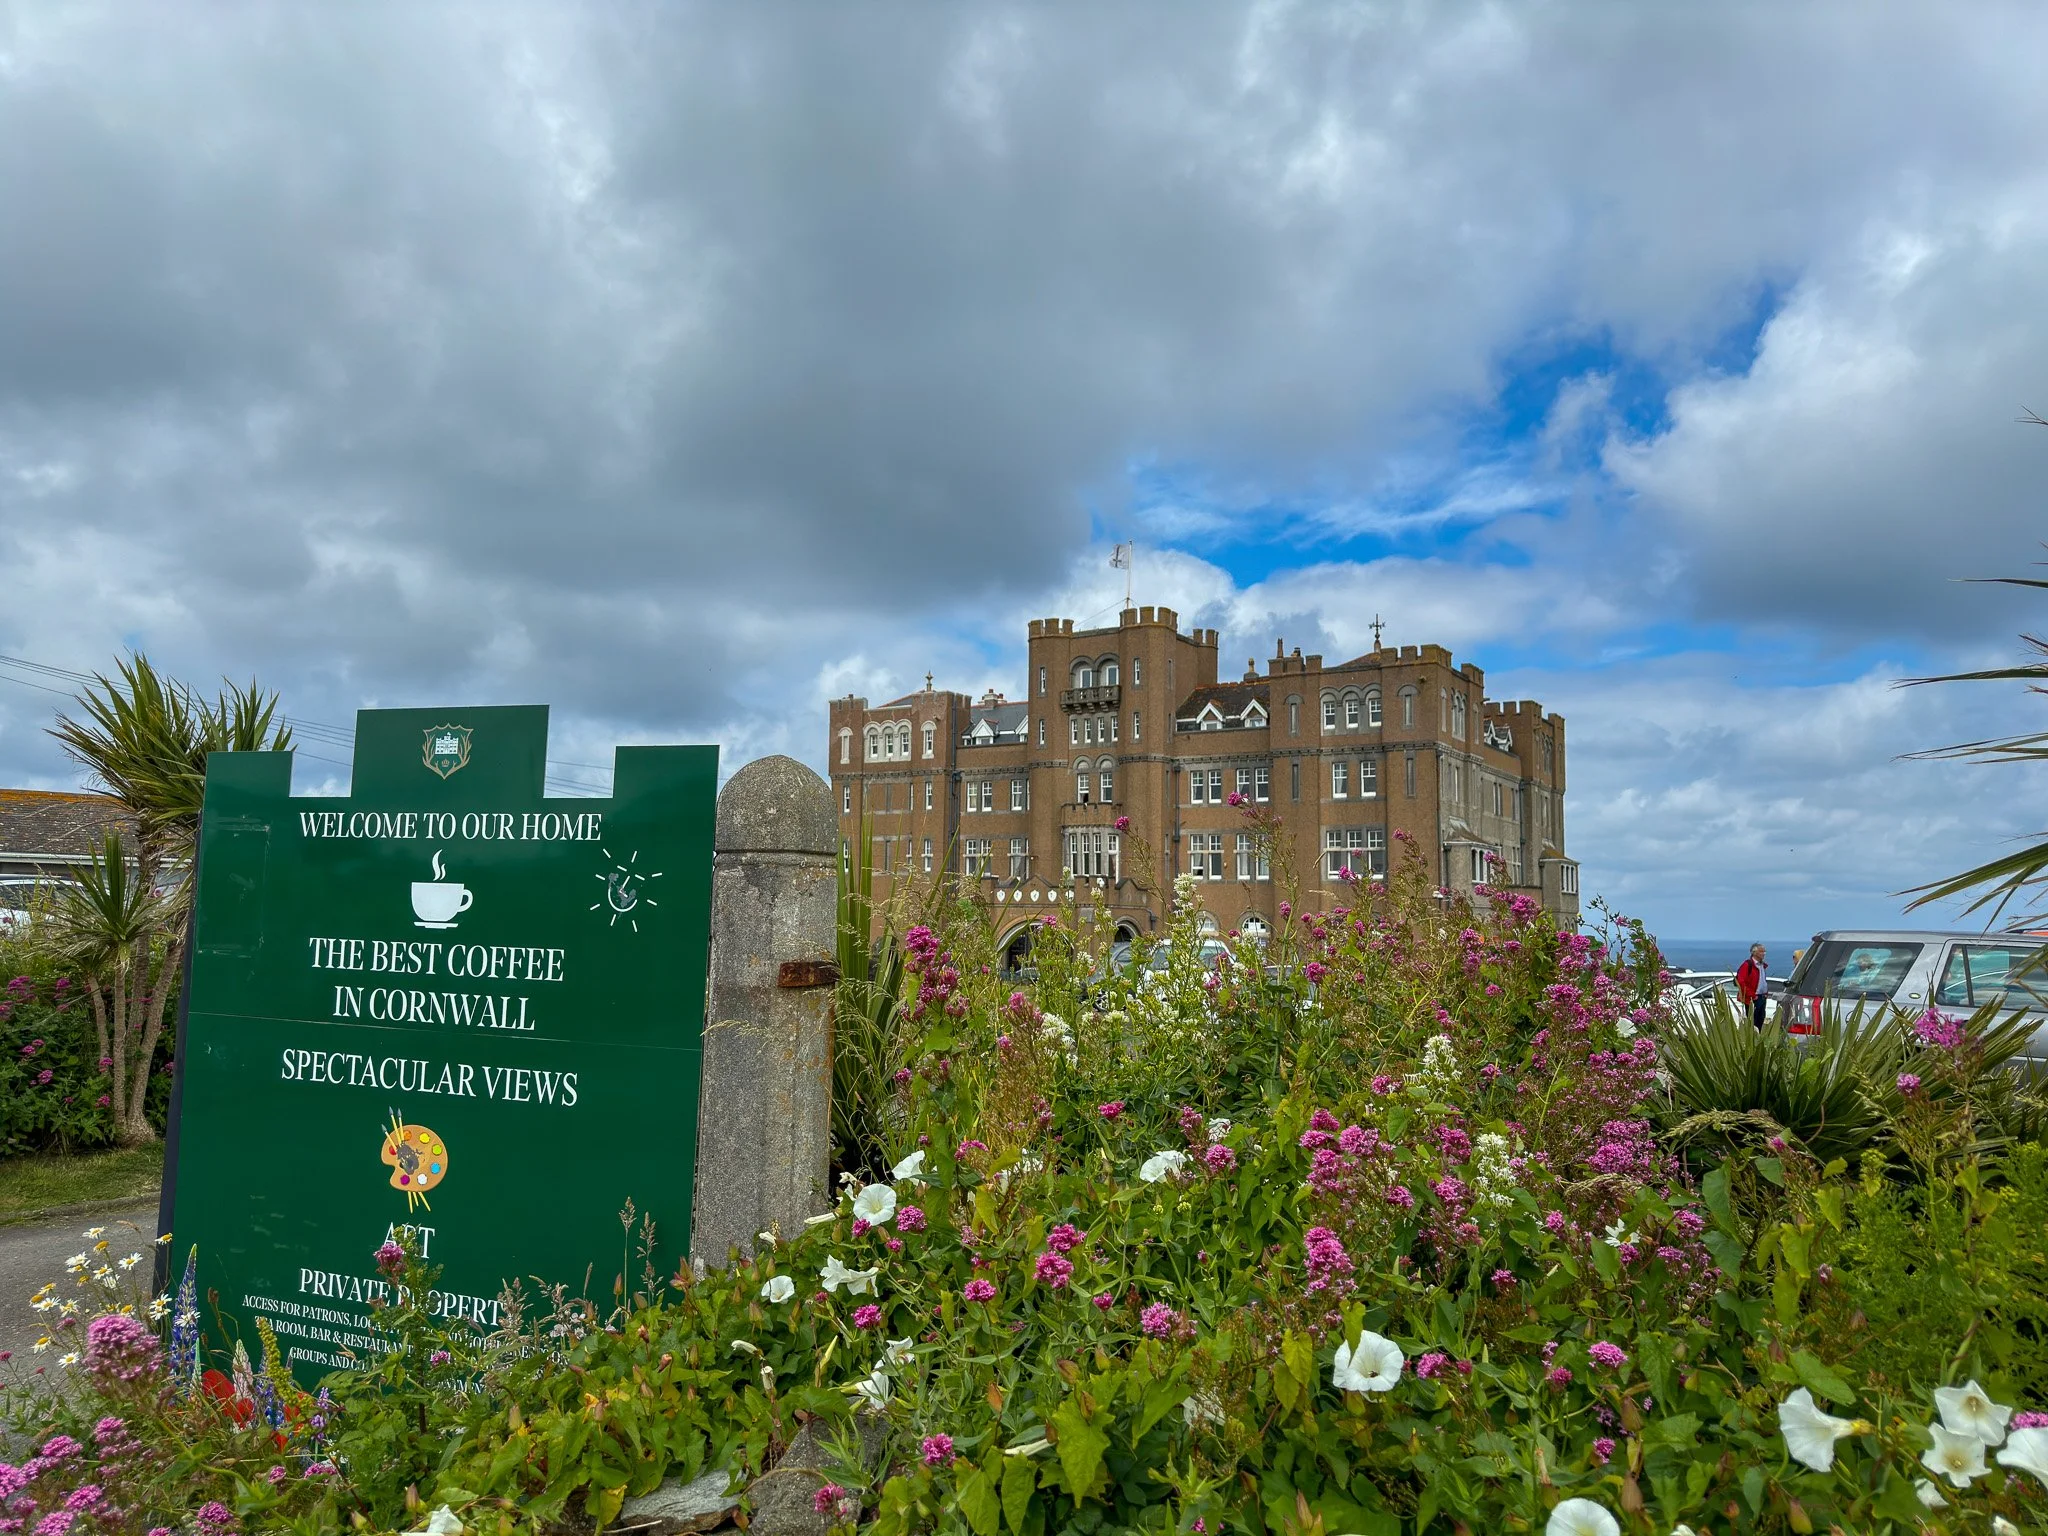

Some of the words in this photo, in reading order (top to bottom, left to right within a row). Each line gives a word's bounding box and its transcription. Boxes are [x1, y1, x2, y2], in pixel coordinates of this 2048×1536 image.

[300, 812, 418, 838] WELCOME
[423, 813, 456, 839] TO
[461, 813, 515, 840] OUR
[519, 813, 602, 841] HOME
[309, 937, 365, 970] THE
[370, 940, 442, 974] BEST
[447, 944, 565, 981] COFFEE
[332, 985, 364, 1018] IN
[369, 988, 535, 1031] CORNWALL
[281, 1049, 476, 1097] SPECTACULAR
[482, 1066, 578, 1107] VIEWS
[299, 1268, 391, 1307] PRIVATE
[242, 1294, 279, 1312] ACCESS
[280, 1301, 300, 1317] FOR
[302, 1305, 352, 1328] PATRONS,
[275, 1320, 309, 1339] ROOM,
[311, 1326, 331, 1342] BAR
[333, 1331, 342, 1344] &
[289, 1346, 327, 1365] GROUPS
[328, 1354, 350, 1369] AND
